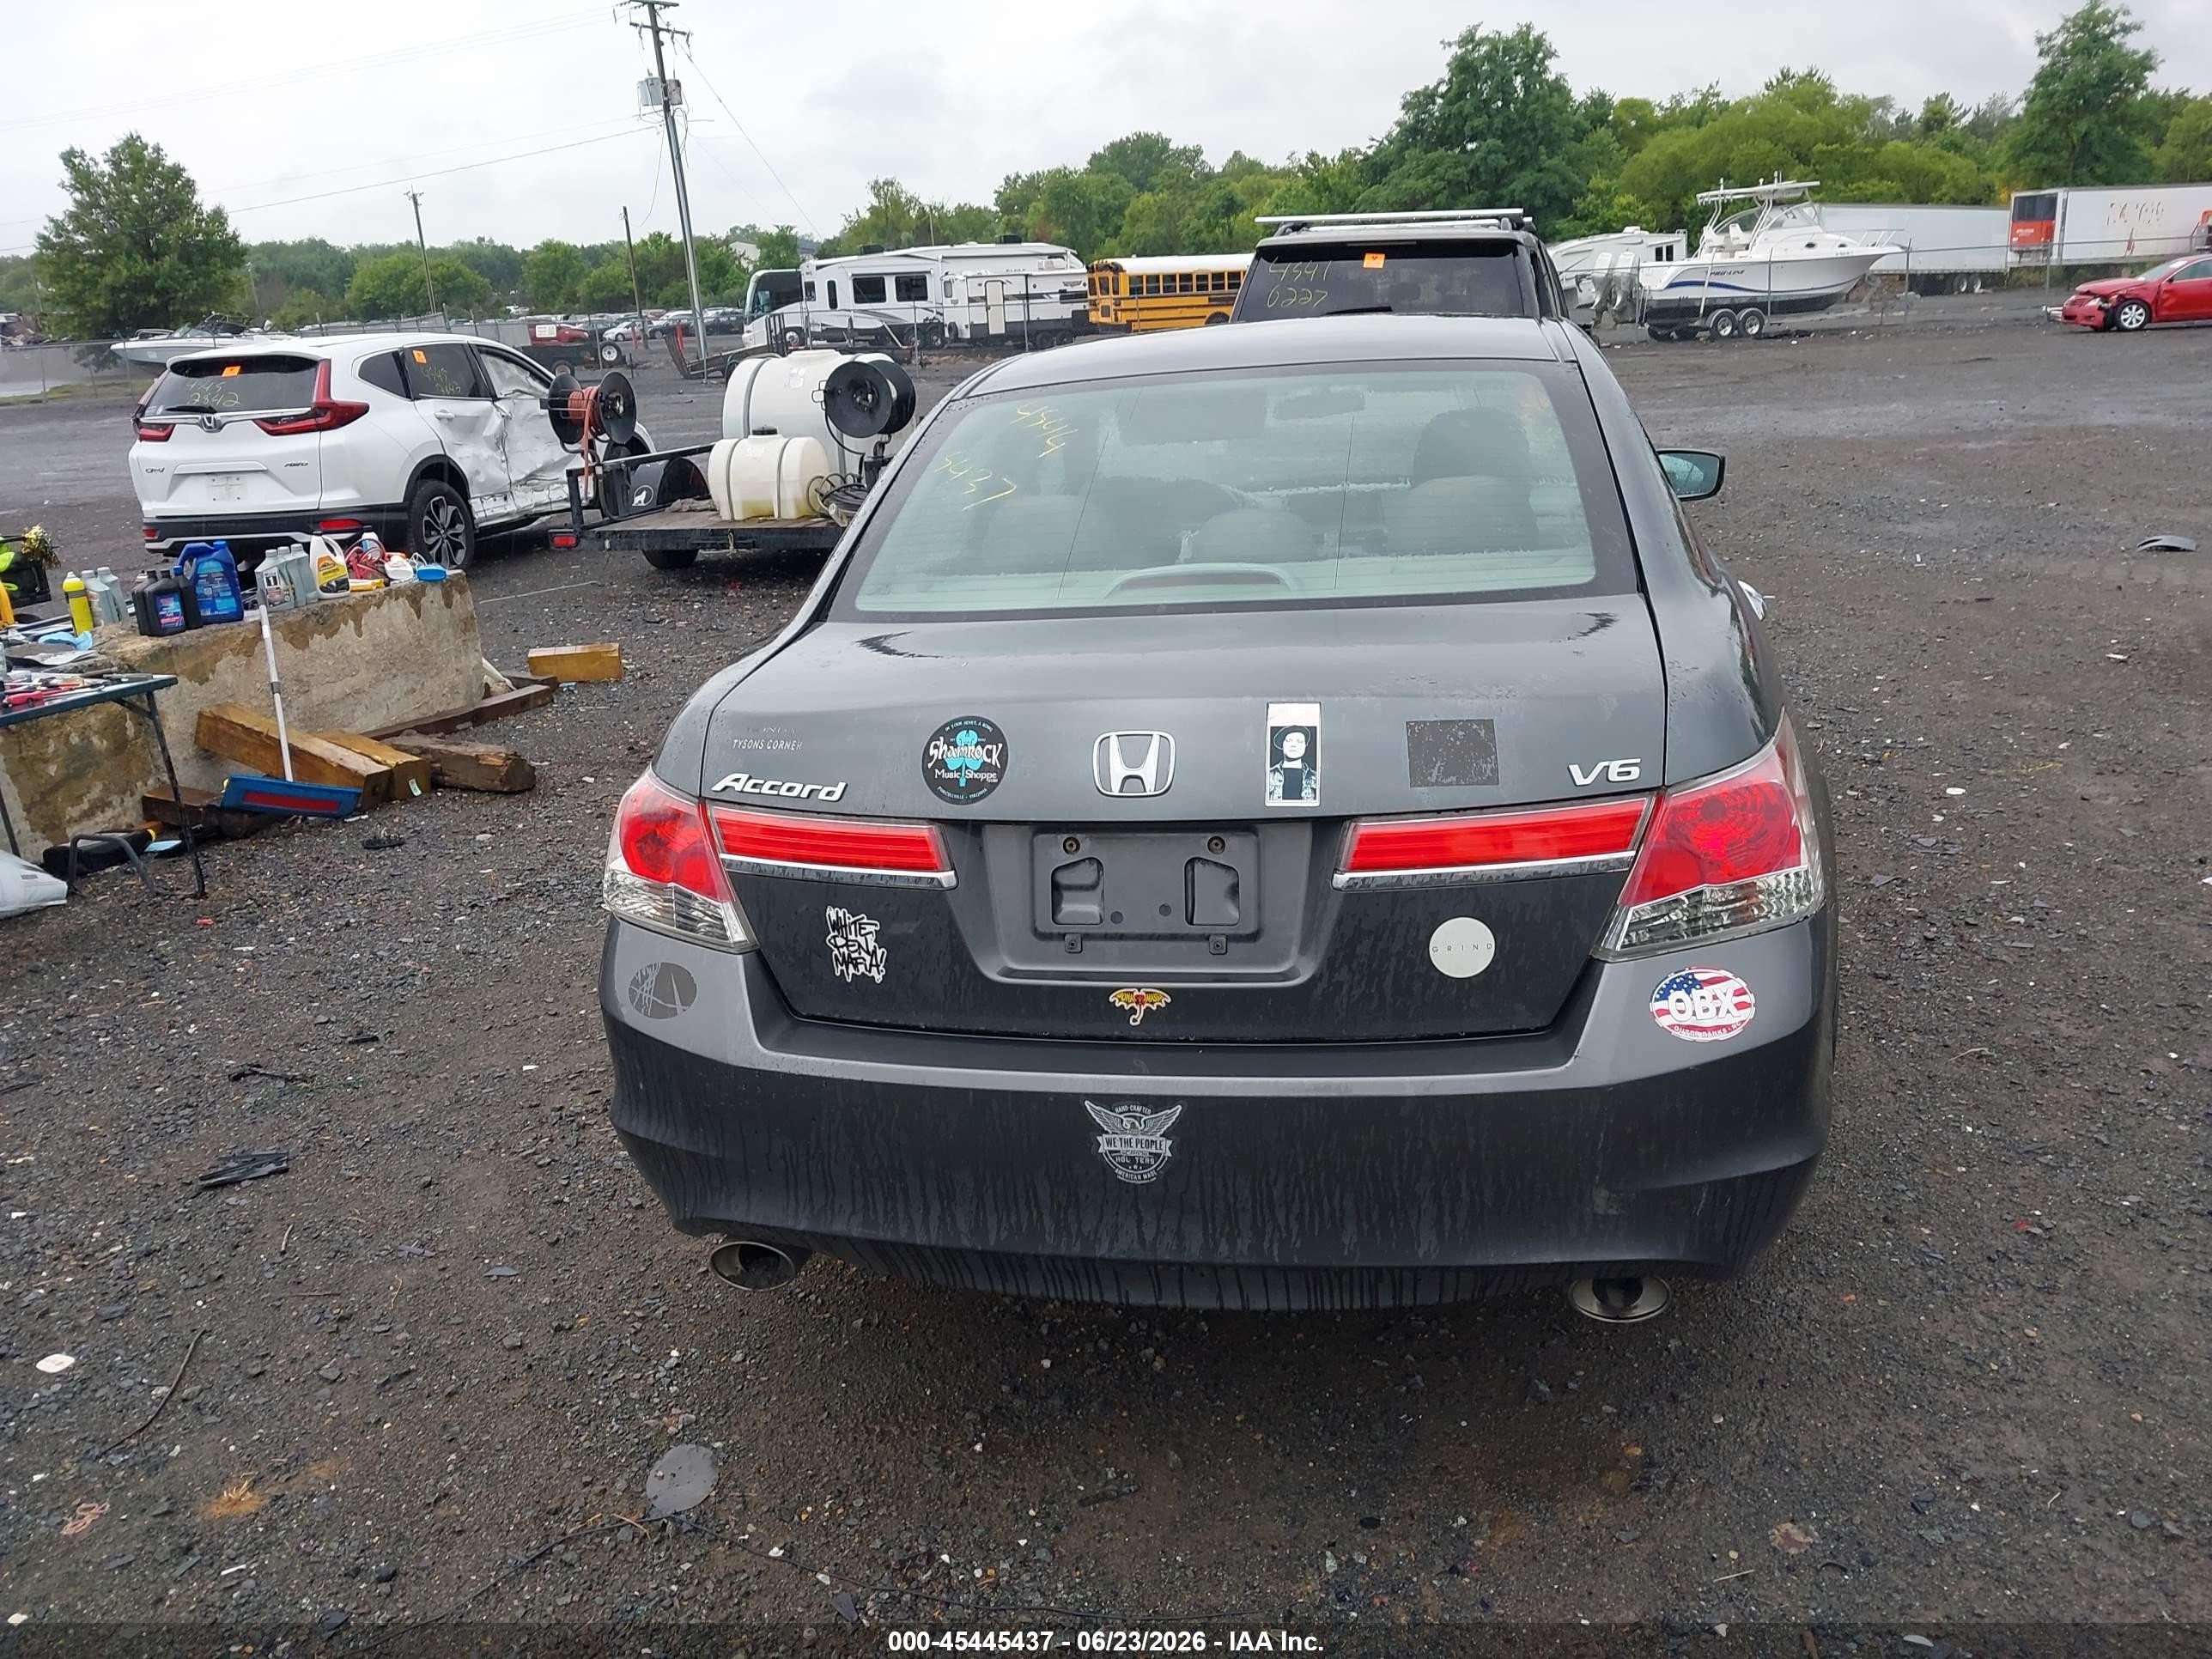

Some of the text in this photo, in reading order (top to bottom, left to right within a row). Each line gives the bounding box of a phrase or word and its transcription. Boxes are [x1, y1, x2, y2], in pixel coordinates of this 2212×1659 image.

[1267, 284, 1329, 308] 6227
[732, 738, 764, 750] TYSONS
[934, 769, 961, 780] Music
[965, 769, 997, 782] Shoppe
[1568, 757, 1642, 787] V6
[711, 773, 848, 802] Accord
[1431, 943, 1492, 953] GRIND
[1668, 988, 1741, 1022] OBX
[1105, 1136, 1164, 1151] WE THE PEOPLE
[1114, 1168, 1142, 1181] AMERICAN
